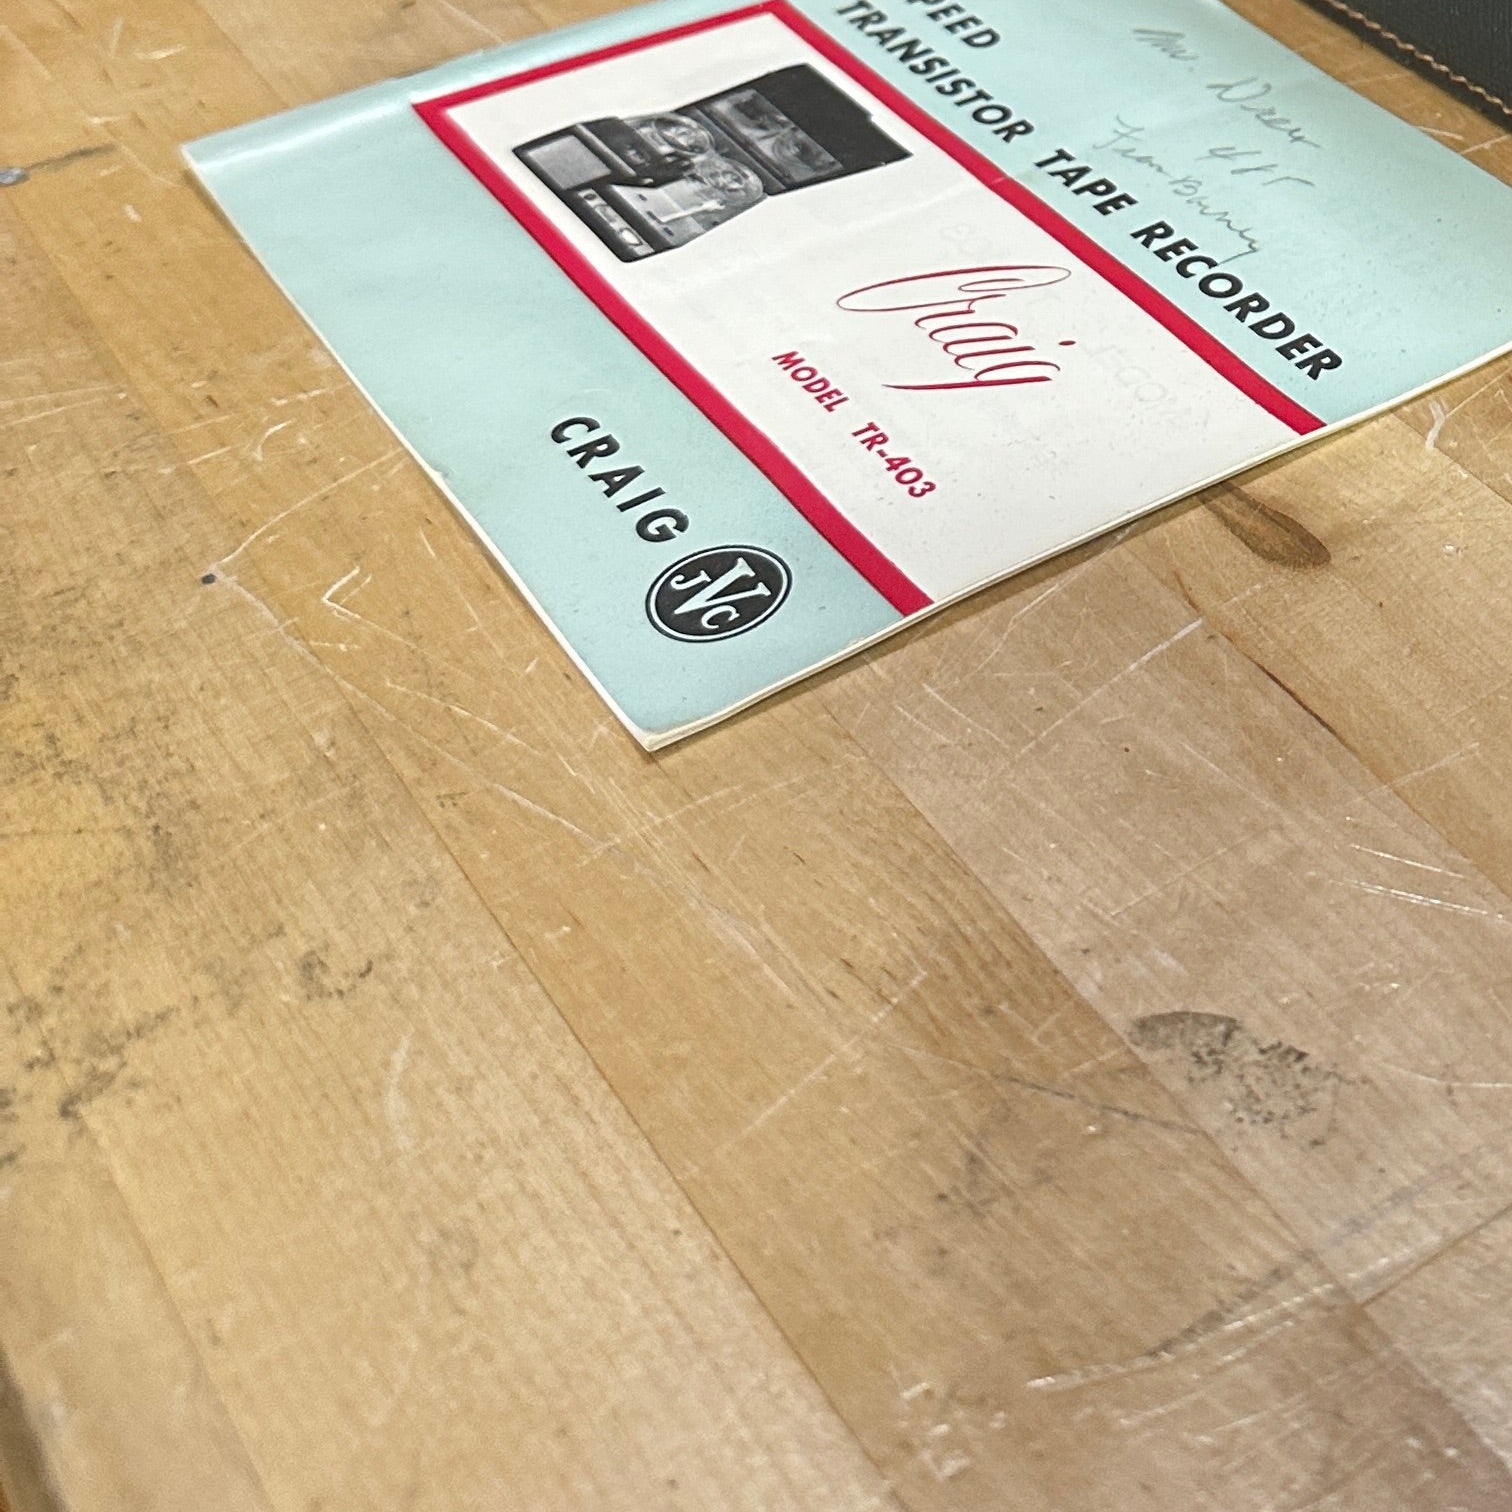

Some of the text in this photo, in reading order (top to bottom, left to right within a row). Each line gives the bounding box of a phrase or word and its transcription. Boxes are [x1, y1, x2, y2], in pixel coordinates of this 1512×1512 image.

[836, 265, 1077, 391] Craig
[1033, 148, 1138, 216] TAPE
[1129, 220, 1344, 381] RECORDER
[550, 416, 690, 543] CRAIG
[771, 350, 937, 499] MODEL TR-403
